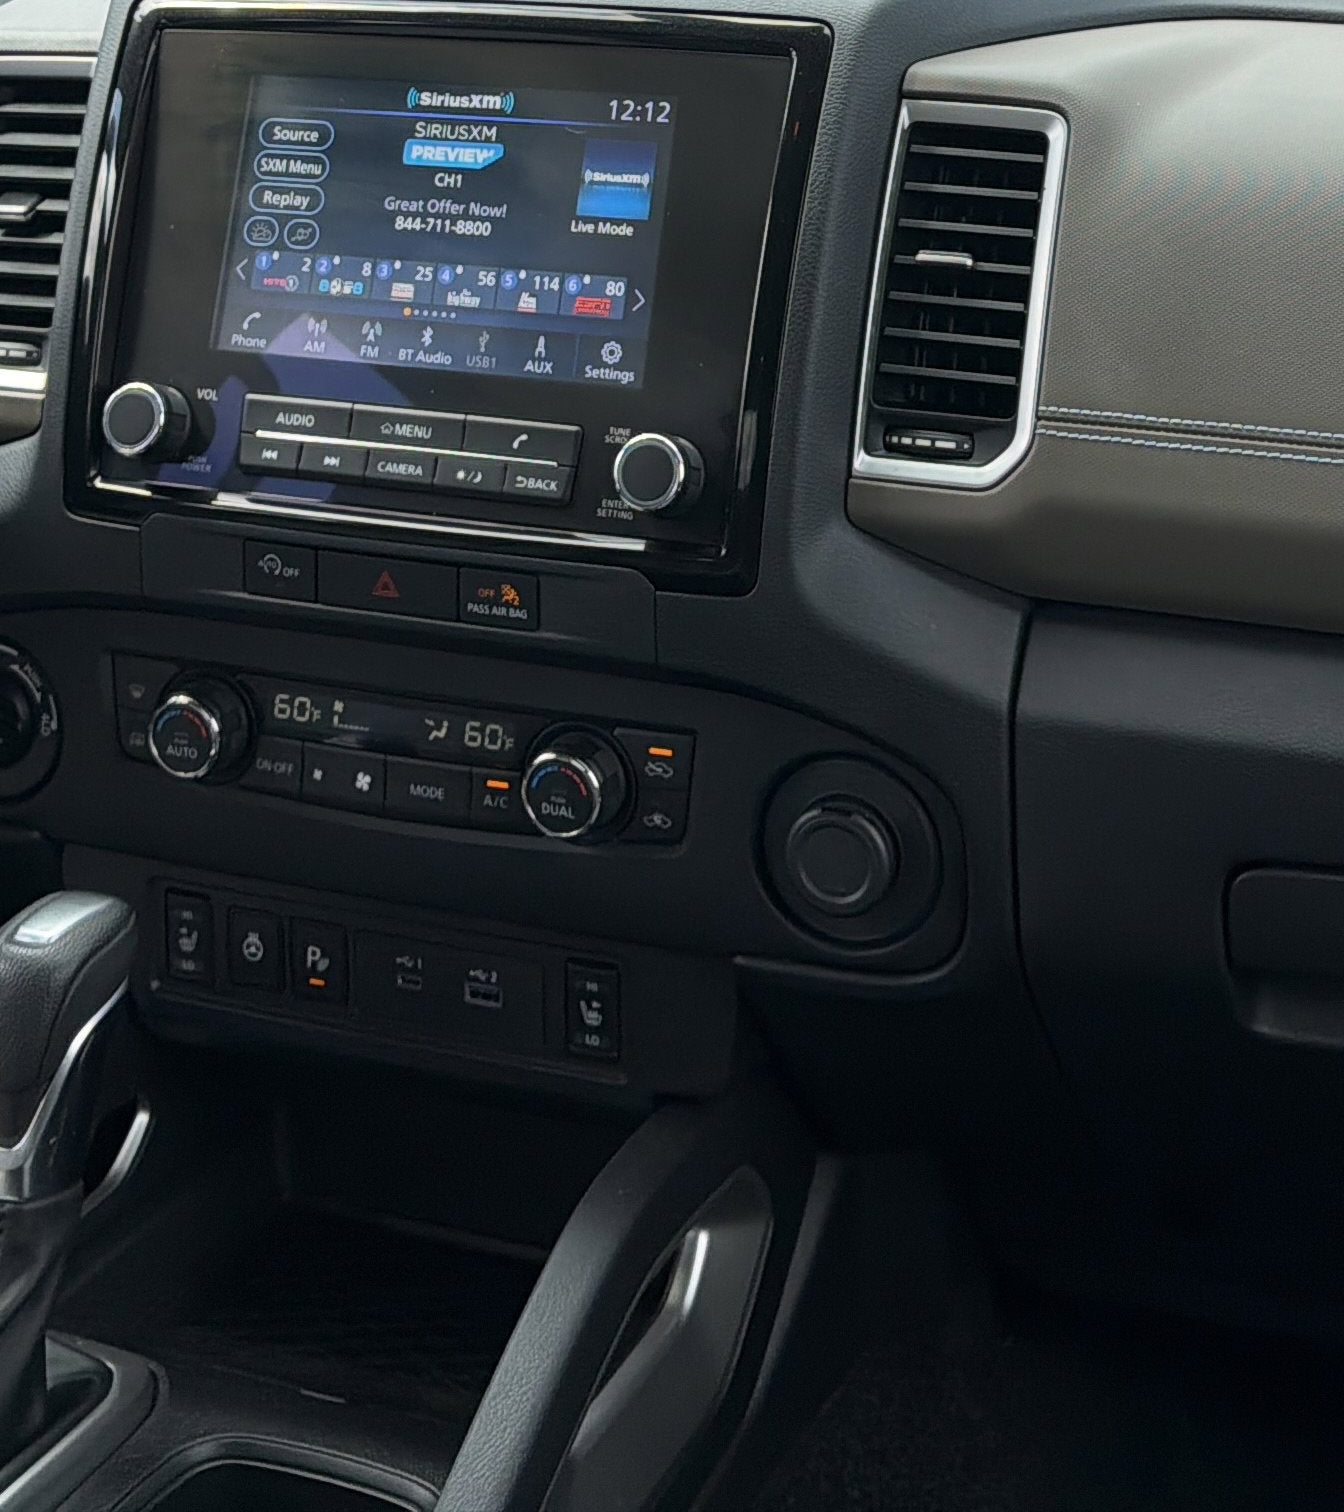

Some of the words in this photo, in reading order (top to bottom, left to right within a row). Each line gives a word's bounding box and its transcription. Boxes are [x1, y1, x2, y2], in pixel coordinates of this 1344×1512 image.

[609, 99, 671, 123] 12:12
[273, 126, 319, 143] Source
[415, 122, 497, 142] SIRIUSXM
[412, 145, 496, 163] PREVIEW
[260, 158, 287, 173] SXM
[289, 160, 322, 176] Menu
[434, 173, 463, 188] CH1
[263, 190, 311, 209] Replay
[384, 196, 425, 213] Great
[427, 199, 465, 214] Offer
[469, 202, 507, 218] Now!
[395, 216, 492, 236] 844-711-8800
[570, 220, 595, 234] Live
[597, 222, 634, 236] Mode
[301, 257, 312, 272] 2
[361, 261, 372, 277] 8
[414, 266, 434, 282] 25
[477, 270, 496, 287] 56
[533, 275, 560, 292] 114
[605, 280, 625, 297] 80
[231, 334, 267, 348] Phone
[303, 341, 326, 354] AM
[360, 345, 379, 359] FM
[398, 349, 412, 361] BT
[416, 350, 452, 366] Audio
[465, 354, 497, 369] USB1
[523, 359, 554, 374] AUX
[584, 365, 635, 386] Settings
[197, 388, 219, 402] VOL
[275, 411, 315, 428] AUDIO
[394, 423, 433, 439] MENU
[609, 427, 631, 438] TUNE
[377, 461, 423, 476] CAMERA
[527, 478, 558, 491] BACK
[596, 508, 634, 521] SETTING
[282, 567, 300, 579] OFF
[478, 587, 496, 599] OFF
[467, 602, 490, 615] PASS
[492, 605, 508, 618] AIR
[509, 607, 528, 620] BAG
[166, 745, 197, 760] AUTO
[409, 783, 445, 801] MODE
[483, 794, 508, 809] A/C
[541, 800, 576, 820] DUAL
